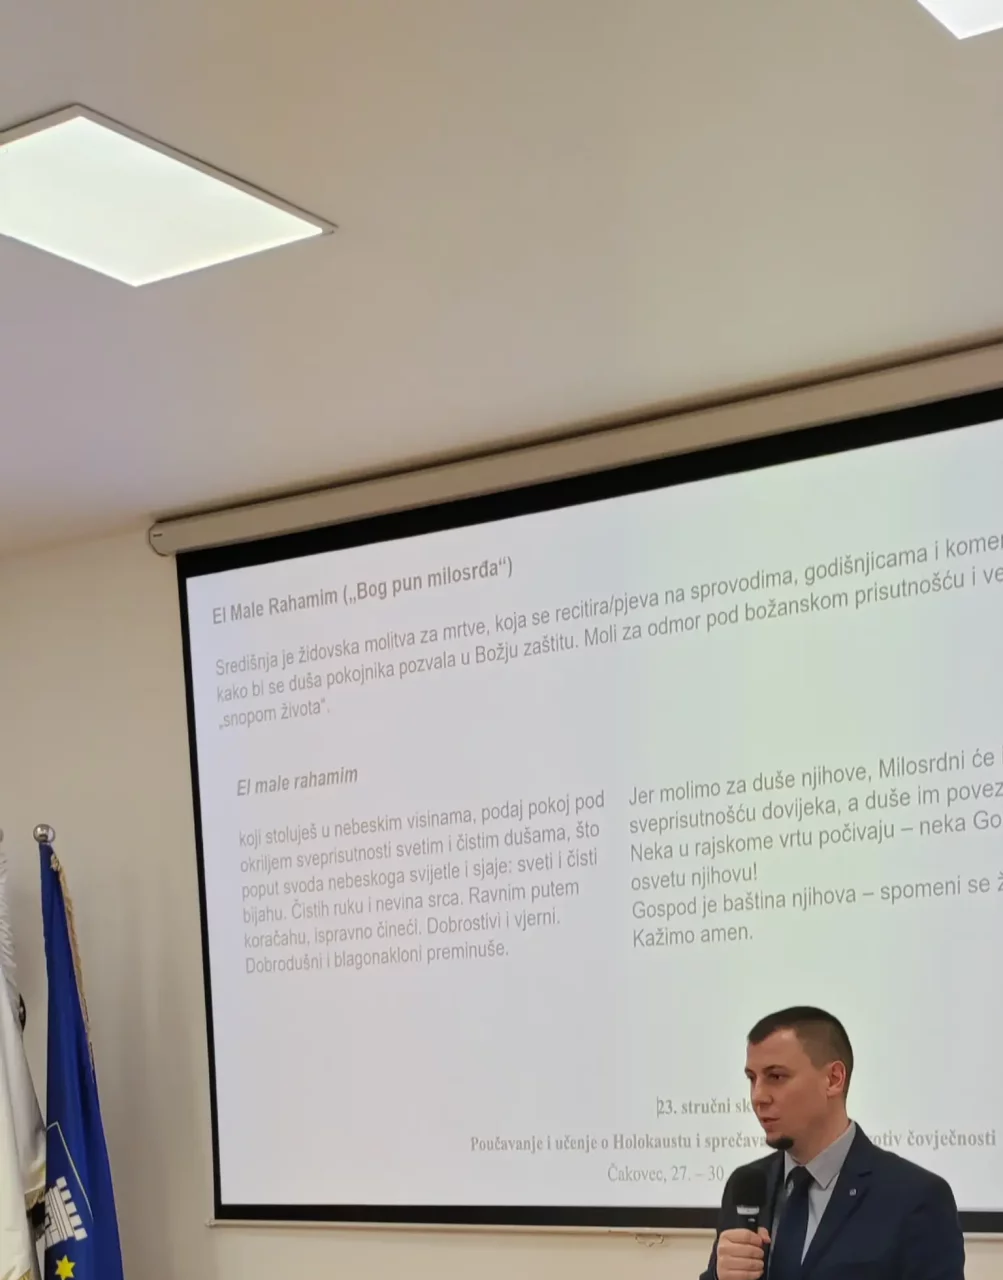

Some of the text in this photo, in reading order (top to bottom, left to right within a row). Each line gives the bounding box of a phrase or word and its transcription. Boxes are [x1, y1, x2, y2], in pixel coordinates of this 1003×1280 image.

[212, 608, 226, 625] El
[230, 602, 264, 621] Male
[269, 588, 338, 616] Rahamim
[392, 575, 424, 598] pun
[215, 652, 278, 676] Središnja
[282, 649, 294, 671] je
[298, 639, 360, 664] židovska
[364, 631, 415, 653] molitva
[420, 628, 438, 644] za
[443, 620, 490, 641] mrtve,
[495, 611, 527, 635] koja
[531, 609, 550, 626] se
[555, 591, 659, 622] recitira/pjeva
[664, 587, 685, 605] na
[690, 569, 798, 603] sprovodima,
[804, 546, 928, 587] godišnjicama
[935, 542, 938, 561] i
[217, 684, 248, 702] kako
[252, 680, 264, 697] bi
[268, 680, 284, 695] se
[288, 671, 322, 692] duša
[326, 661, 395, 689] pokojnika
[399, 650, 456, 680] pozvala
[461, 651, 470, 666] u
[475, 641, 518, 664] Božju
[523, 633, 579, 657] zaštitu.
[584, 623, 617, 647] Moli
[622, 624, 642, 641] za
[647, 614, 701, 637] odmor
[706, 604, 739, 633] pod
[744, 591, 848, 622] božanskom
[855, 572, 964, 610] prisutnošću
[972, 568, 975, 586] i
[236, 766, 358, 797] El male rahamim
[628, 786, 655, 806] Jer
[660, 780, 721, 803] molimo
[726, 779, 746, 795] za
[752, 770, 795, 792] duše
[801, 765, 872, 791] njihove,
[879, 751, 965, 779] Milosrdni
[972, 750, 995, 768] će
[239, 791, 605, 850] koji stoluješ u nebeskim visinama, podaj pokoj pod
[629, 804, 756, 836] sveprisutnošću
[762, 797, 841, 822] dovijeka,
[848, 797, 859, 812] a
[865, 789, 911, 810] duše
[918, 787, 940, 806] im
[240, 820, 600, 875] okriljem sveprisutnosti svetim i čistim dušama, što
[630, 841, 673, 862] Neka
[679, 843, 689, 857] u
[695, 834, 773, 860] rajskome
[778, 829, 812, 849] vrtu
[819, 821, 894, 850] počivaju
[919, 816, 966, 836] neka
[241, 848, 597, 902] poput svoda nebeskoga svijetle i sjaje: sveti i čisti
[631, 863, 757, 891] osvetu njihovu!
[242, 881, 579, 927] bijahu. Čistih ruku i nevina srca. Ravnim putem
[632, 896, 697, 922] Gospod
[703, 895, 717, 919] je
[723, 891, 786, 912] baština
[792, 887, 856, 912] njihova
[880, 876, 961, 905] spomeni
[967, 878, 990, 894] se
[244, 907, 560, 948] koračahu, ispravno čineći. Dobrostivi i vjerni.
[633, 925, 753, 948] Kažimo amen.
[245, 939, 509, 974] Dobrodušni i blagonakloni preminuše.
[657, 1097, 751, 1116] 23. stručni sk
[470, 1135, 543, 1155] Poučavanje
[546, 1135, 551, 1150] i
[554, 1134, 597, 1153] učenje
[600, 1138, 609, 1149] o
[613, 1133, 691, 1150] Holokaustu
[695, 1132, 701, 1148] i
[907, 1129, 997, 1151] čovječnosti
[607, 1162, 667, 1184] Čakovec,
[670, 1166, 691, 1181] 27.
